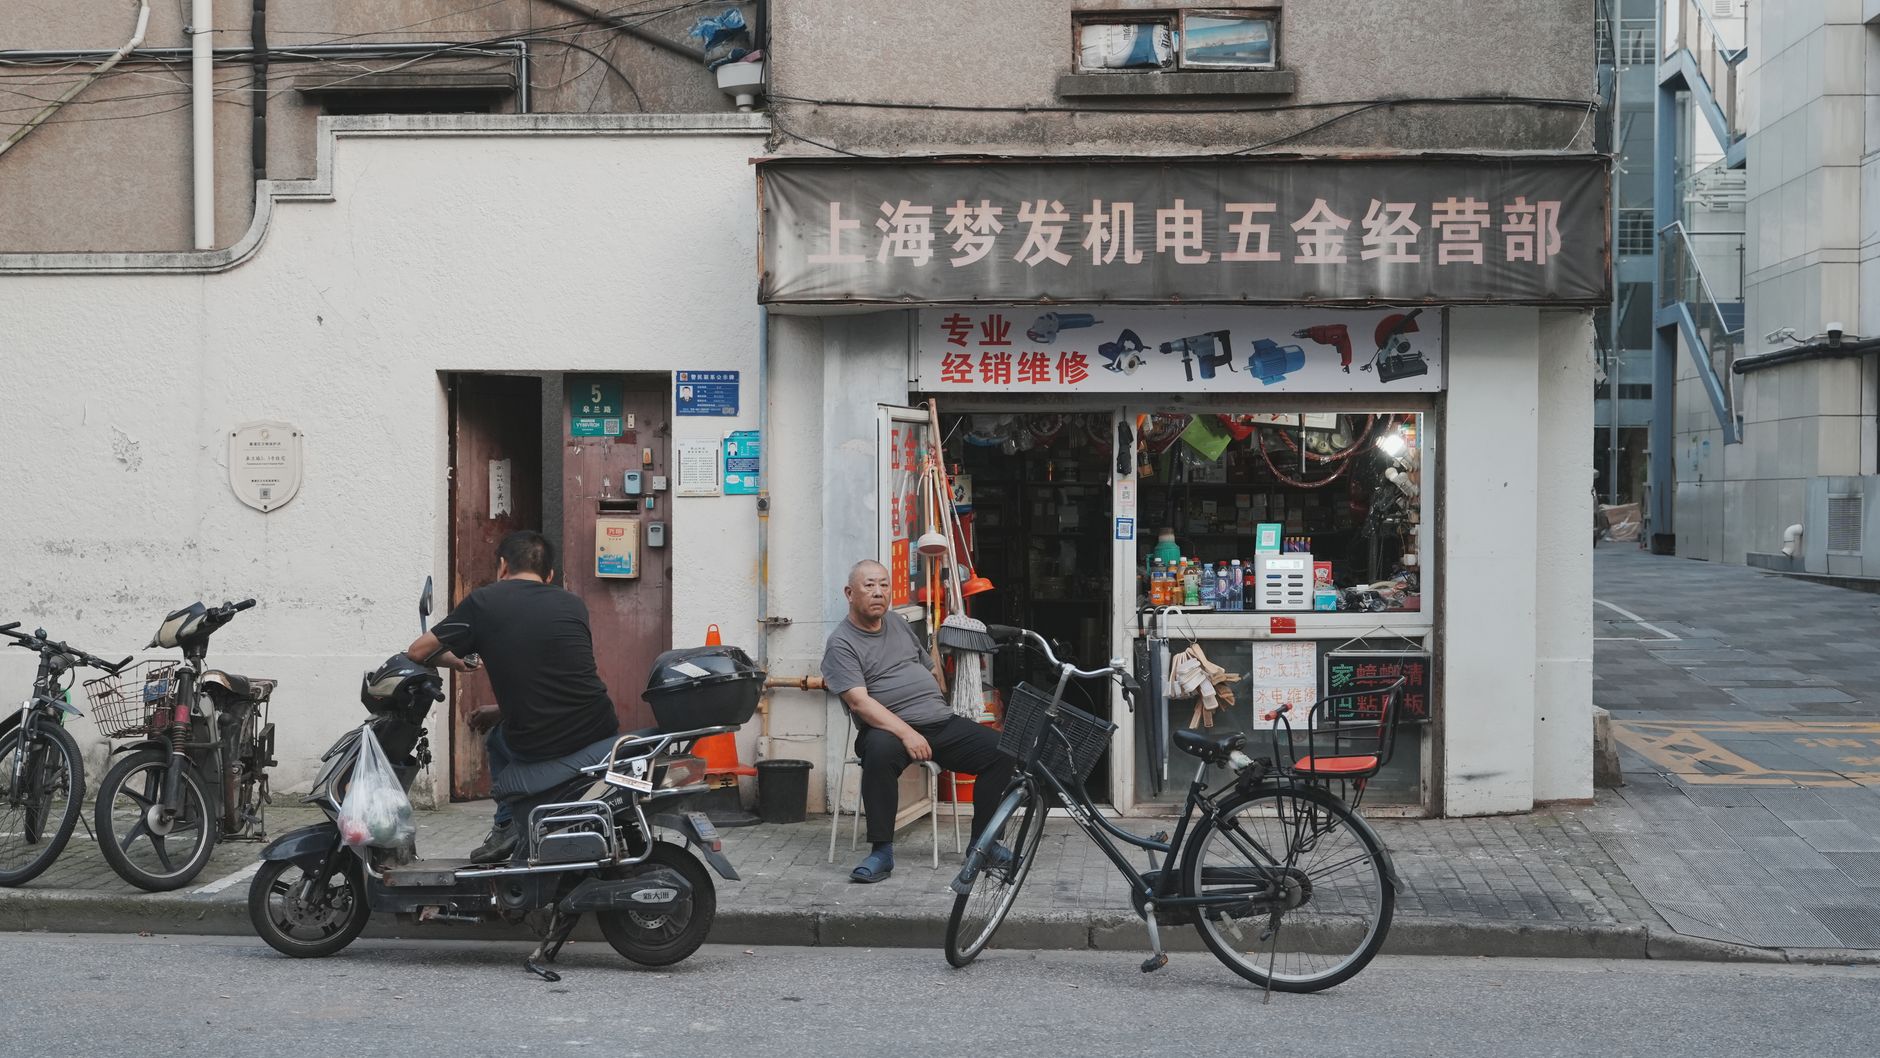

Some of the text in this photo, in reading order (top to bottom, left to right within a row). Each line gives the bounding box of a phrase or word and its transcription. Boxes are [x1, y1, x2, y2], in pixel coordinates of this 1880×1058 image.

[807, 196, 1562, 267] 上海梦发机电五金经营部
[941, 314, 1012, 346] 专业
[941, 351, 1090, 385] 经销维修
[591, 384, 602, 403] 5
